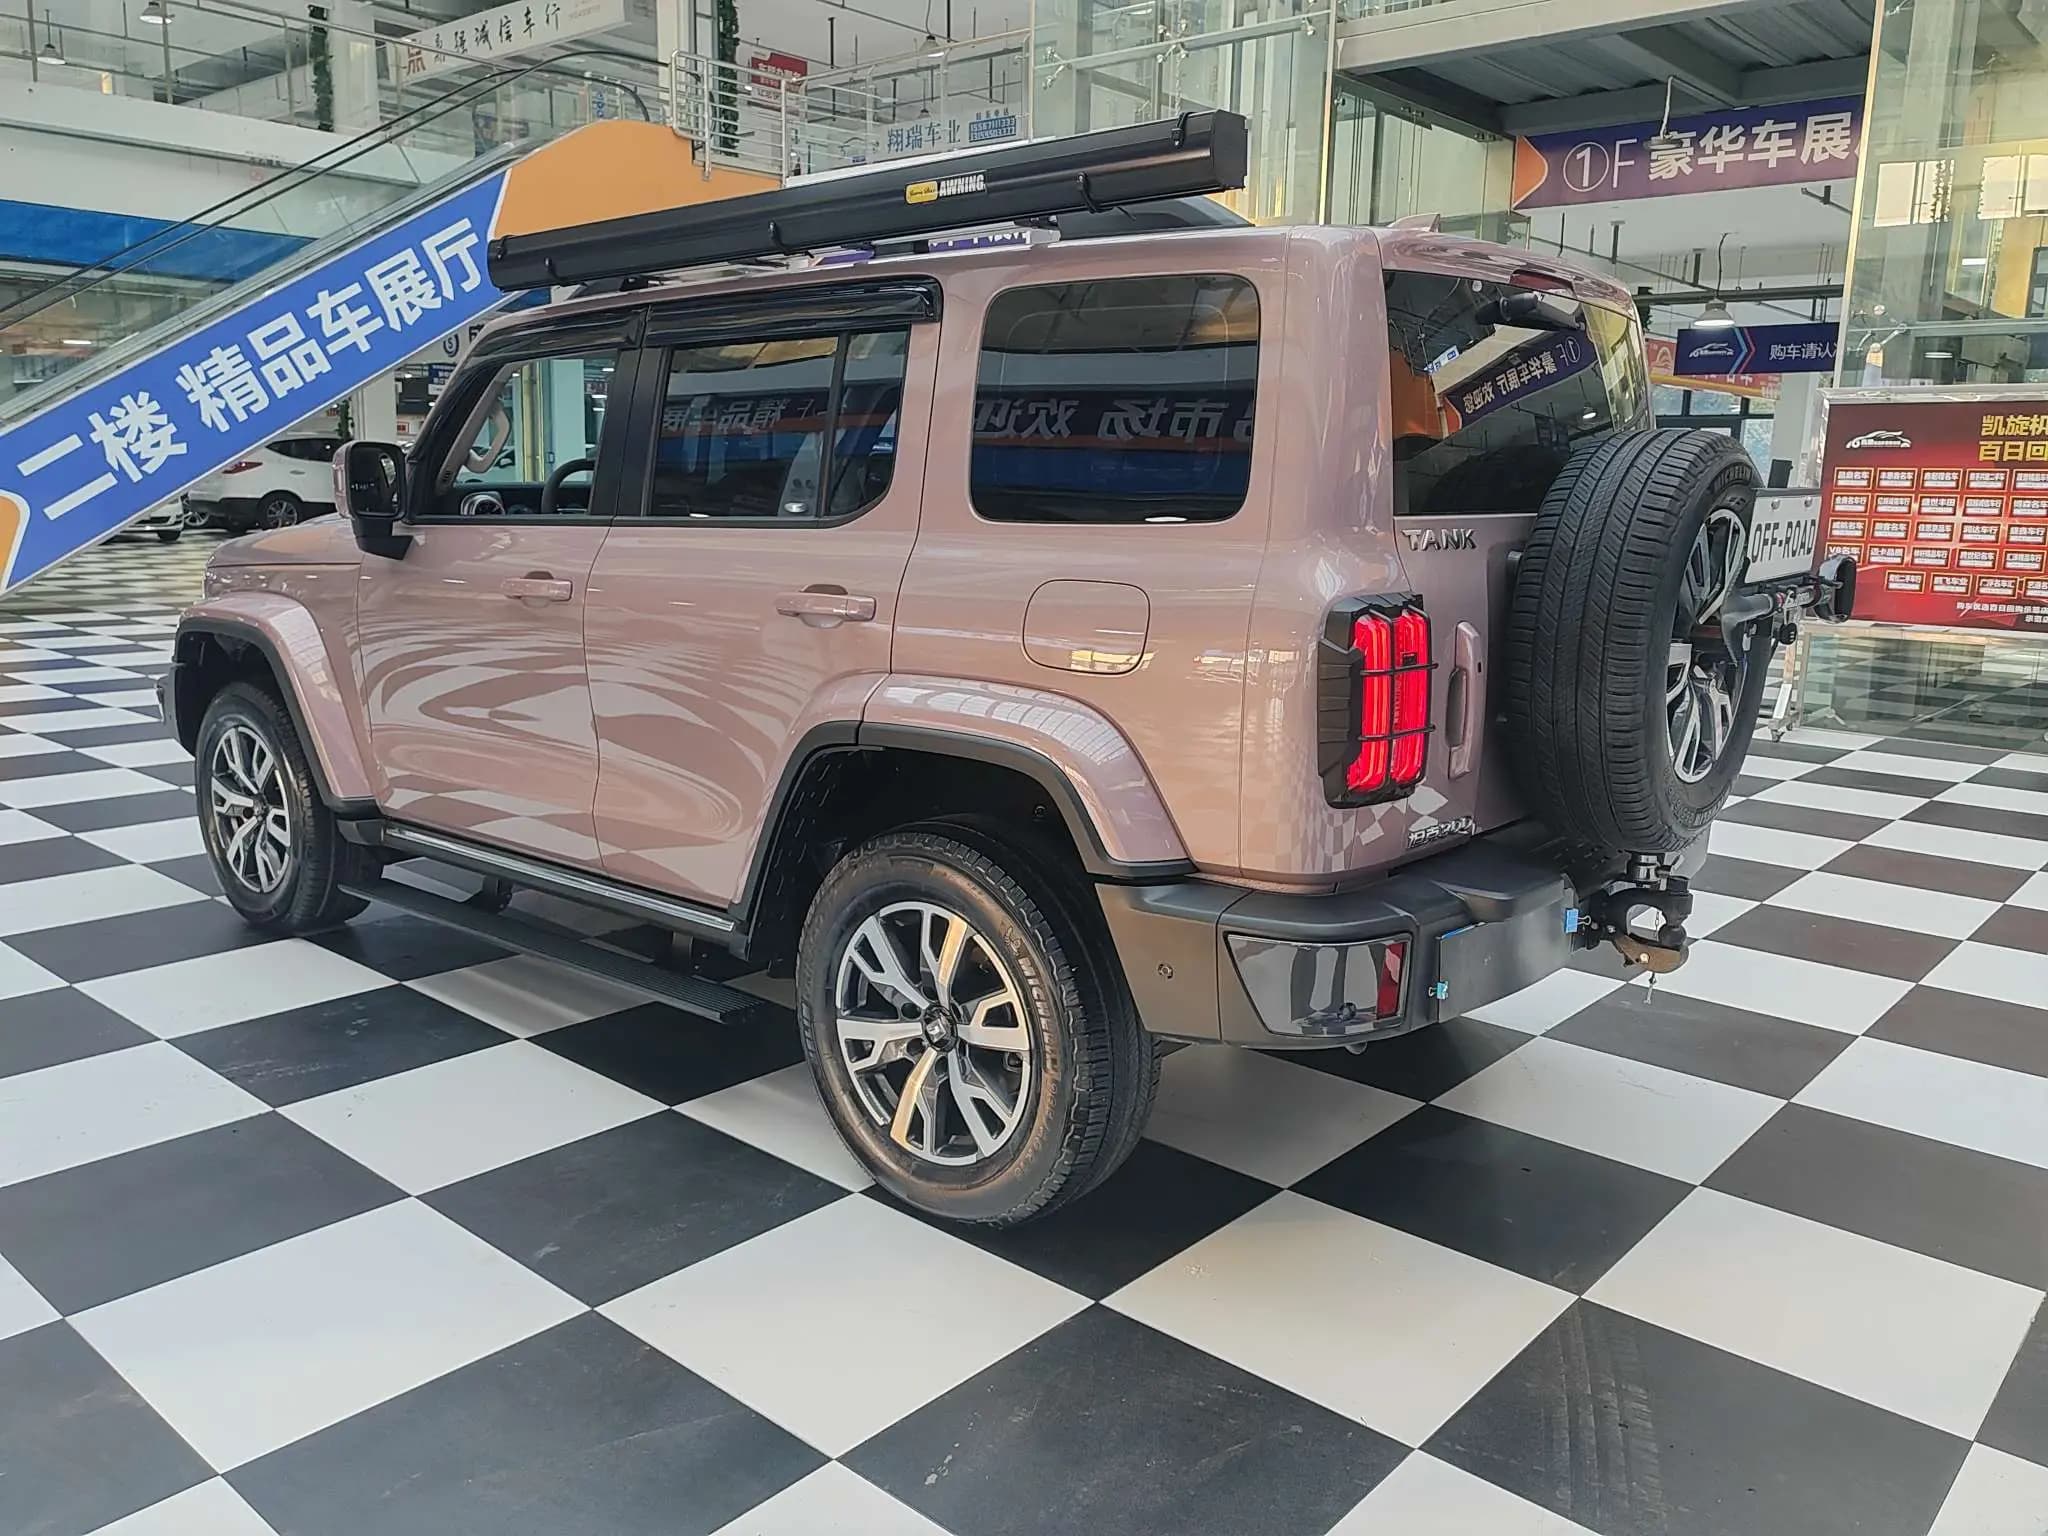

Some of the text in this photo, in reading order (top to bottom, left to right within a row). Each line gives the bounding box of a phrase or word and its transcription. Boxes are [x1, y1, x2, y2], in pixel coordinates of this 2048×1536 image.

[887, 119, 961, 154] 翔瑞车业
[1648, 112, 1861, 181] 豪华车展
[939, 174, 985, 197] AWNING
[17, 217, 483, 521] 二楼 精品车展厅
[1402, 528, 1477, 551] TANK
[1751, 519, 1816, 563] OFF-ROAD
